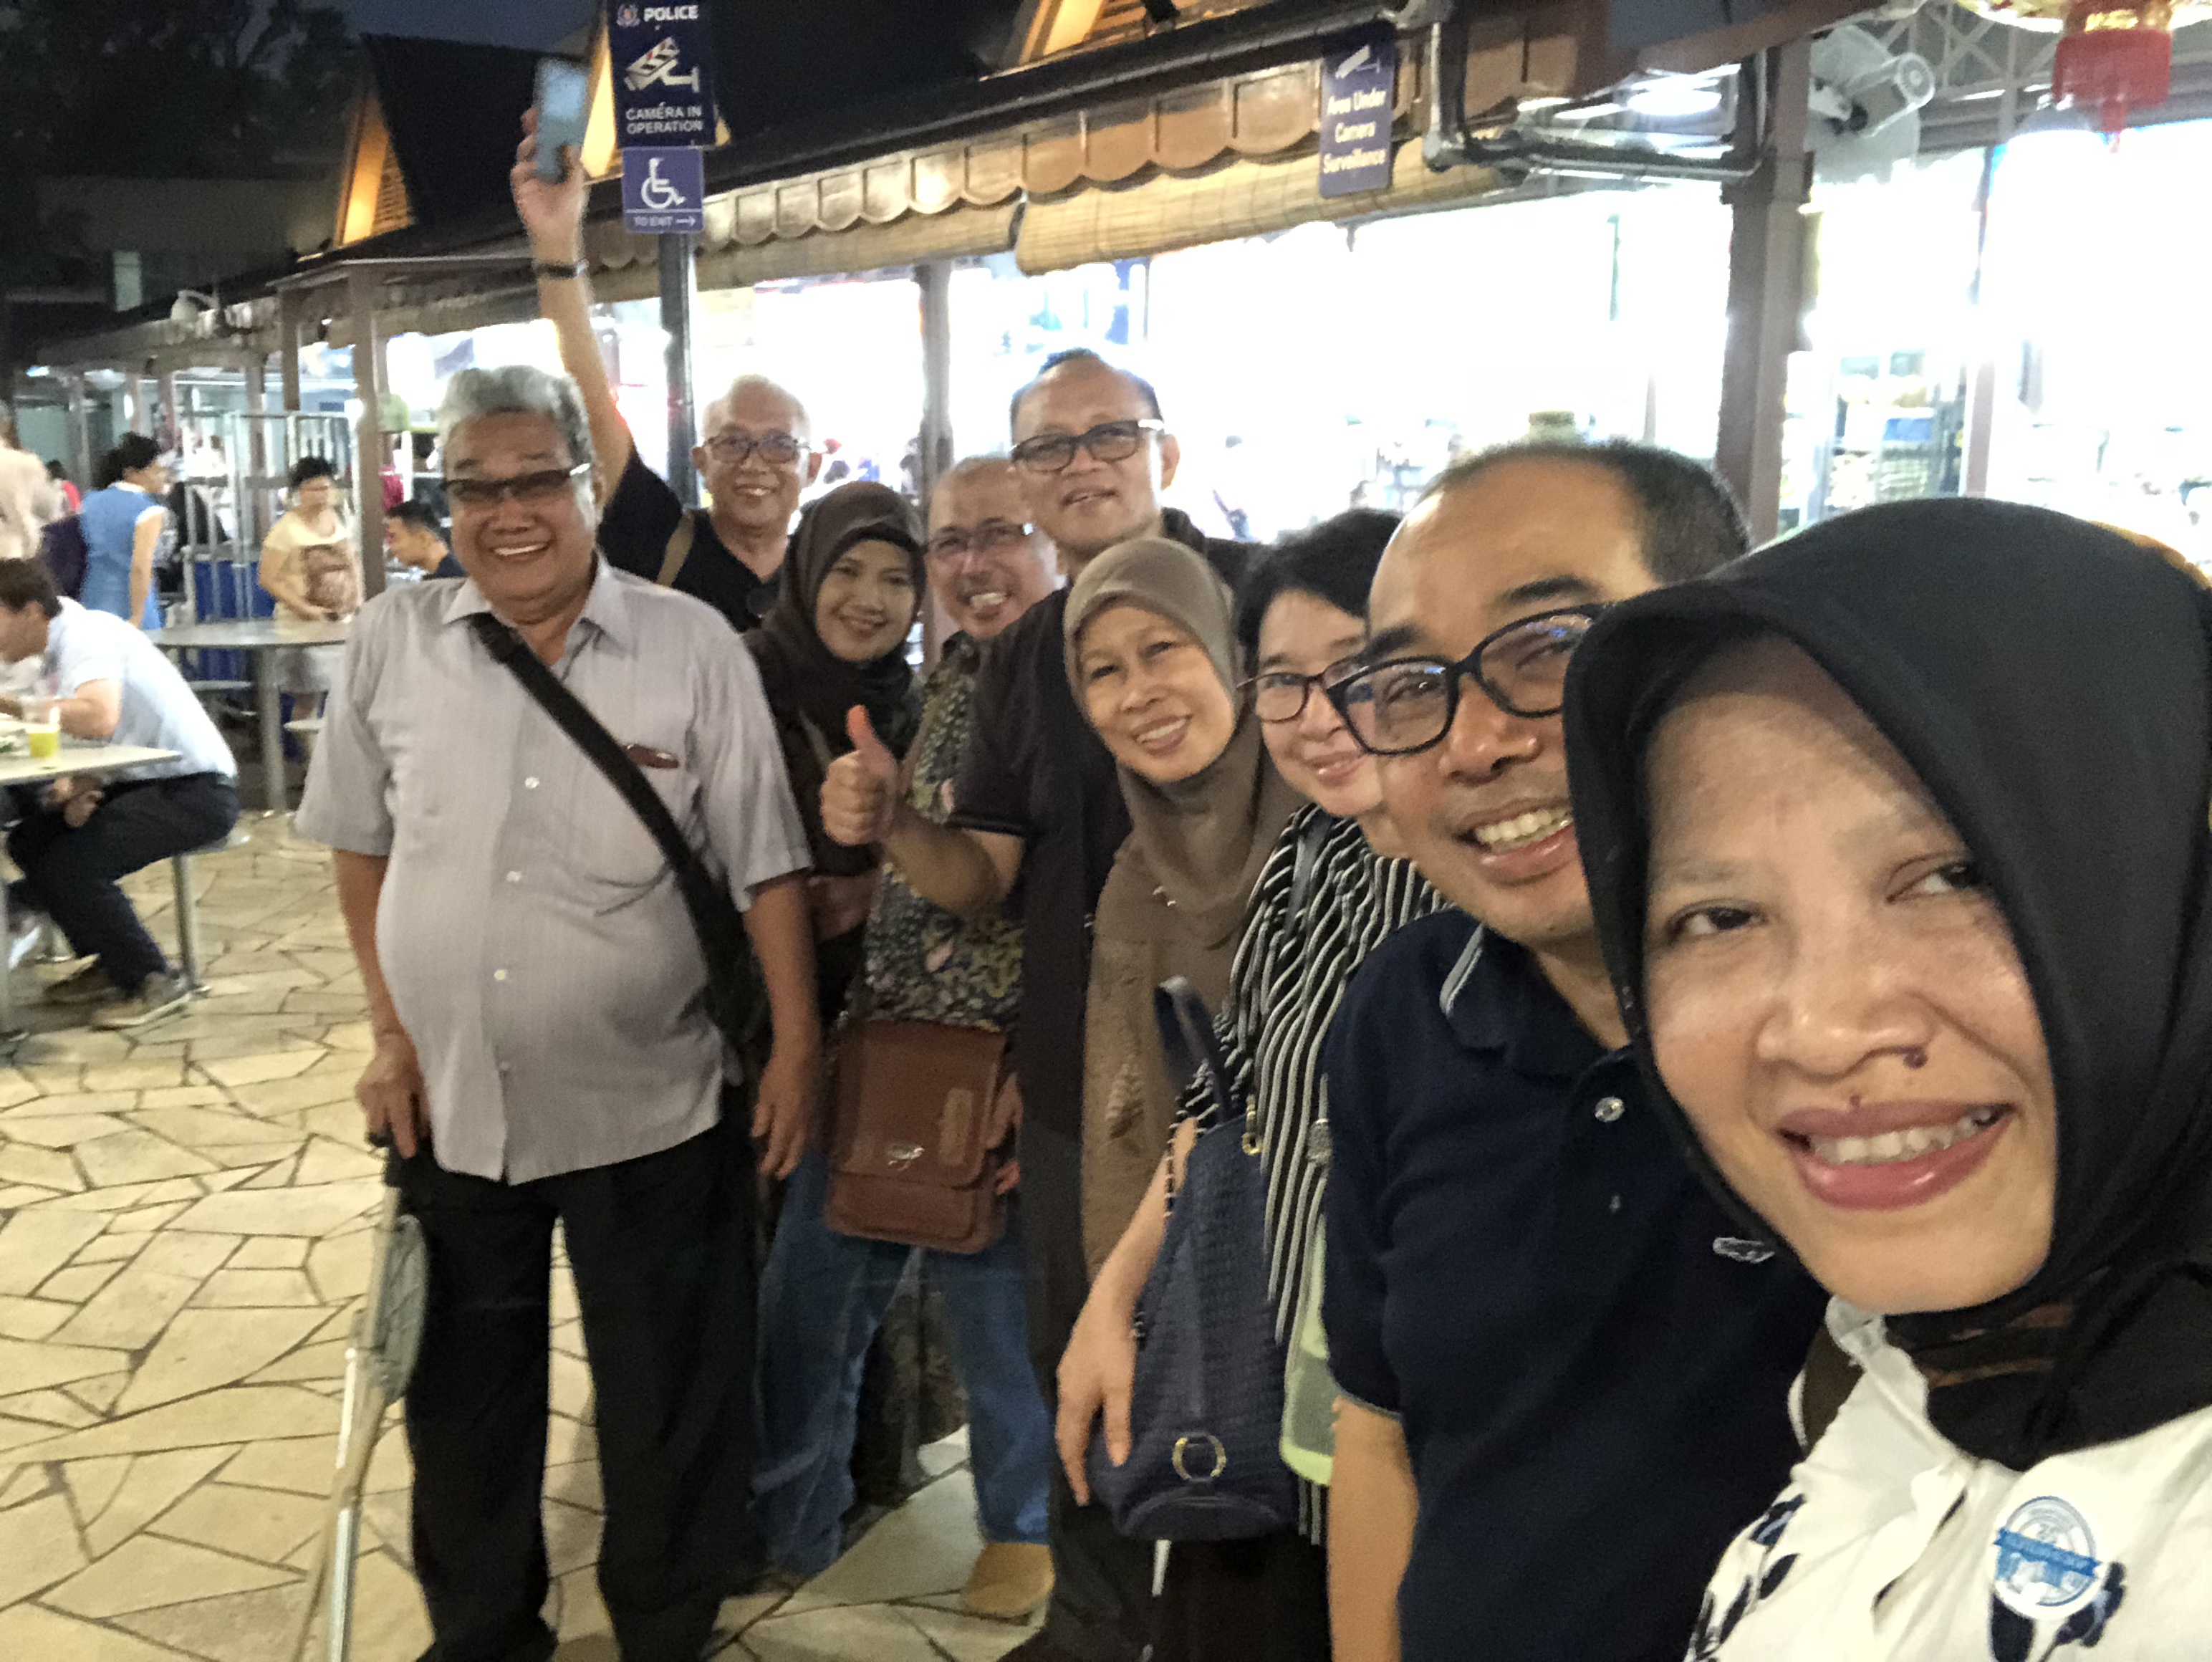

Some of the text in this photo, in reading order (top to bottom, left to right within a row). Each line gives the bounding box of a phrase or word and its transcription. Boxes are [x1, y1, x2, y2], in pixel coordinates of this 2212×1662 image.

[643, 5, 699, 21] POLICE
[625, 105, 702, 120] CAMERA IN
[626, 120, 703, 135] OPERATION
